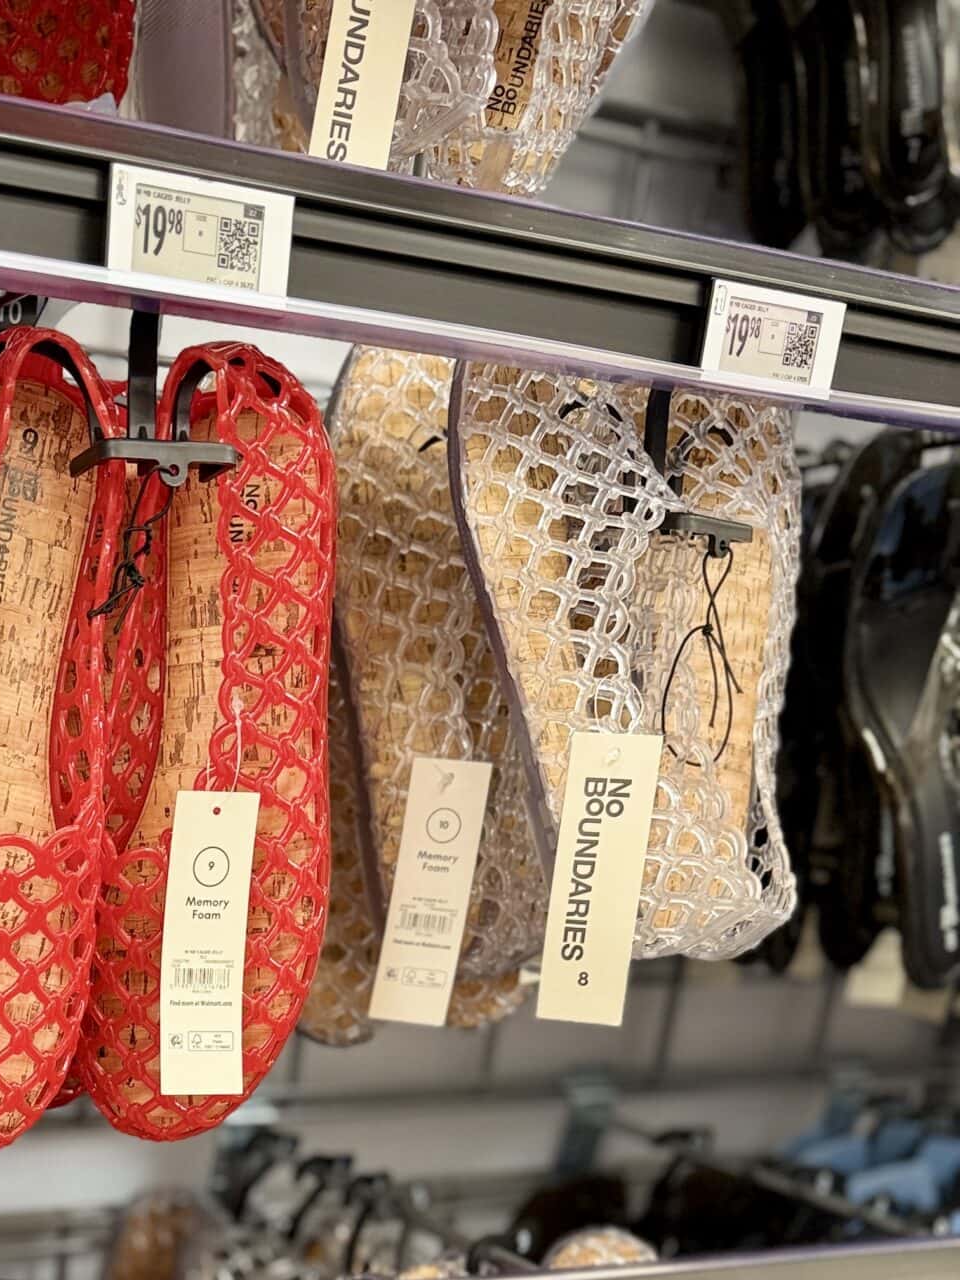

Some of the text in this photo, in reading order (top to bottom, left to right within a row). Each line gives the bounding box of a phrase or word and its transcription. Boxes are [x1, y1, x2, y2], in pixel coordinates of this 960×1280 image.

[487, 84, 505, 111] NO
[604, 777, 632, 818] NO
[439, 820, 449, 830] 10
[417, 850, 459, 865] Memory
[208, 860, 215, 872] 9
[421, 862, 450, 874] Foam
[560, 776, 608, 962] BOUNDARIES
[185, 896, 229, 908] Memory
[192, 909, 222, 921] Foam
[577, 971, 589, 986] 8
